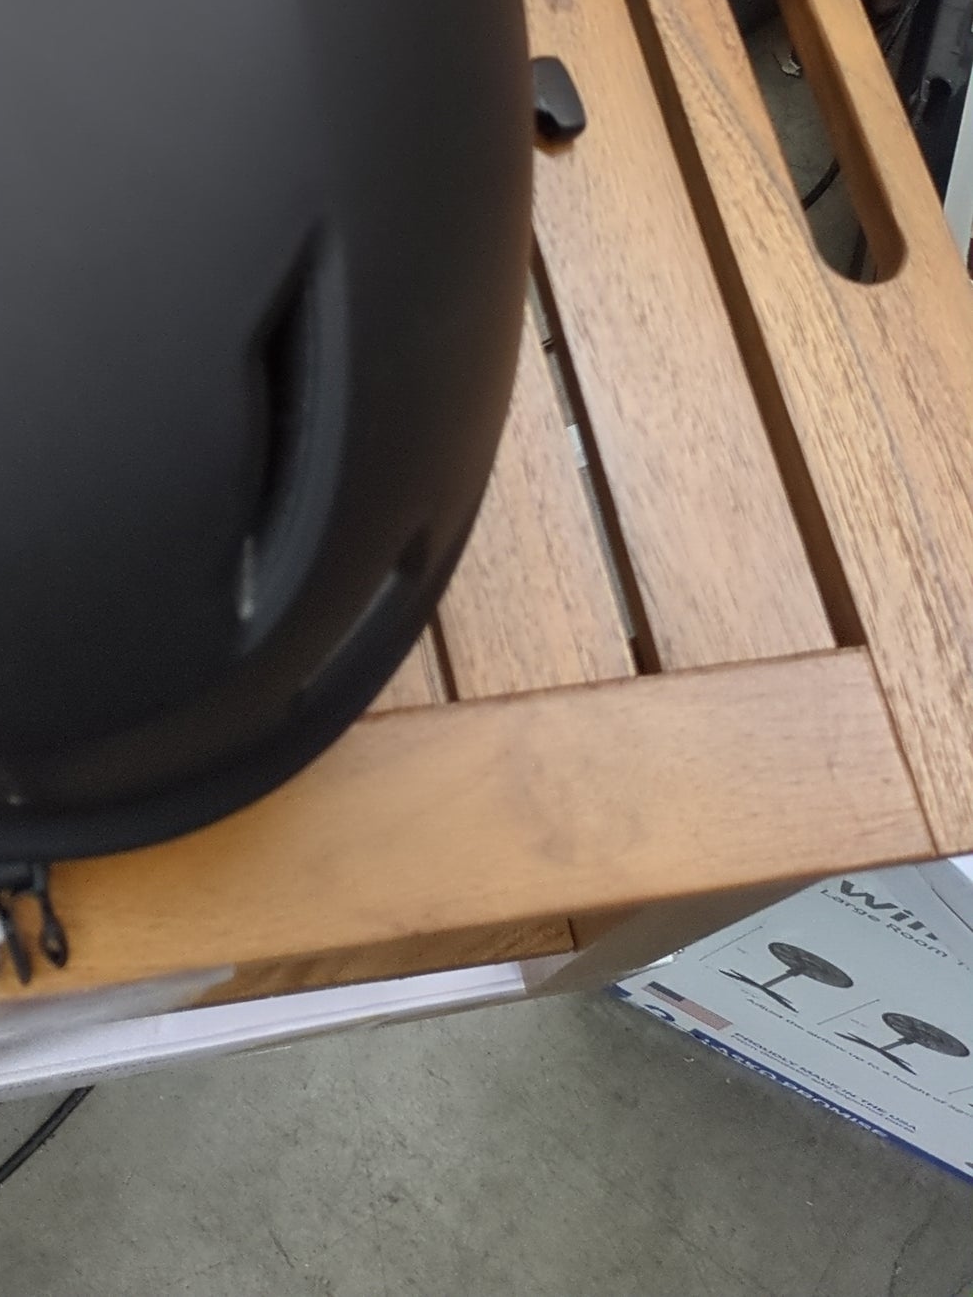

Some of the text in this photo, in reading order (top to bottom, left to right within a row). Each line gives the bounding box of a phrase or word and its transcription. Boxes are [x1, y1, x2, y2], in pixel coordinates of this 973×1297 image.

[820, 889, 948, 958] Large Room
[734, 1032, 798, 1066] PROUDLY
[799, 1065, 839, 1089] MADE
[860, 1098, 887, 1114] THE
[888, 1113, 917, 1131] USA
